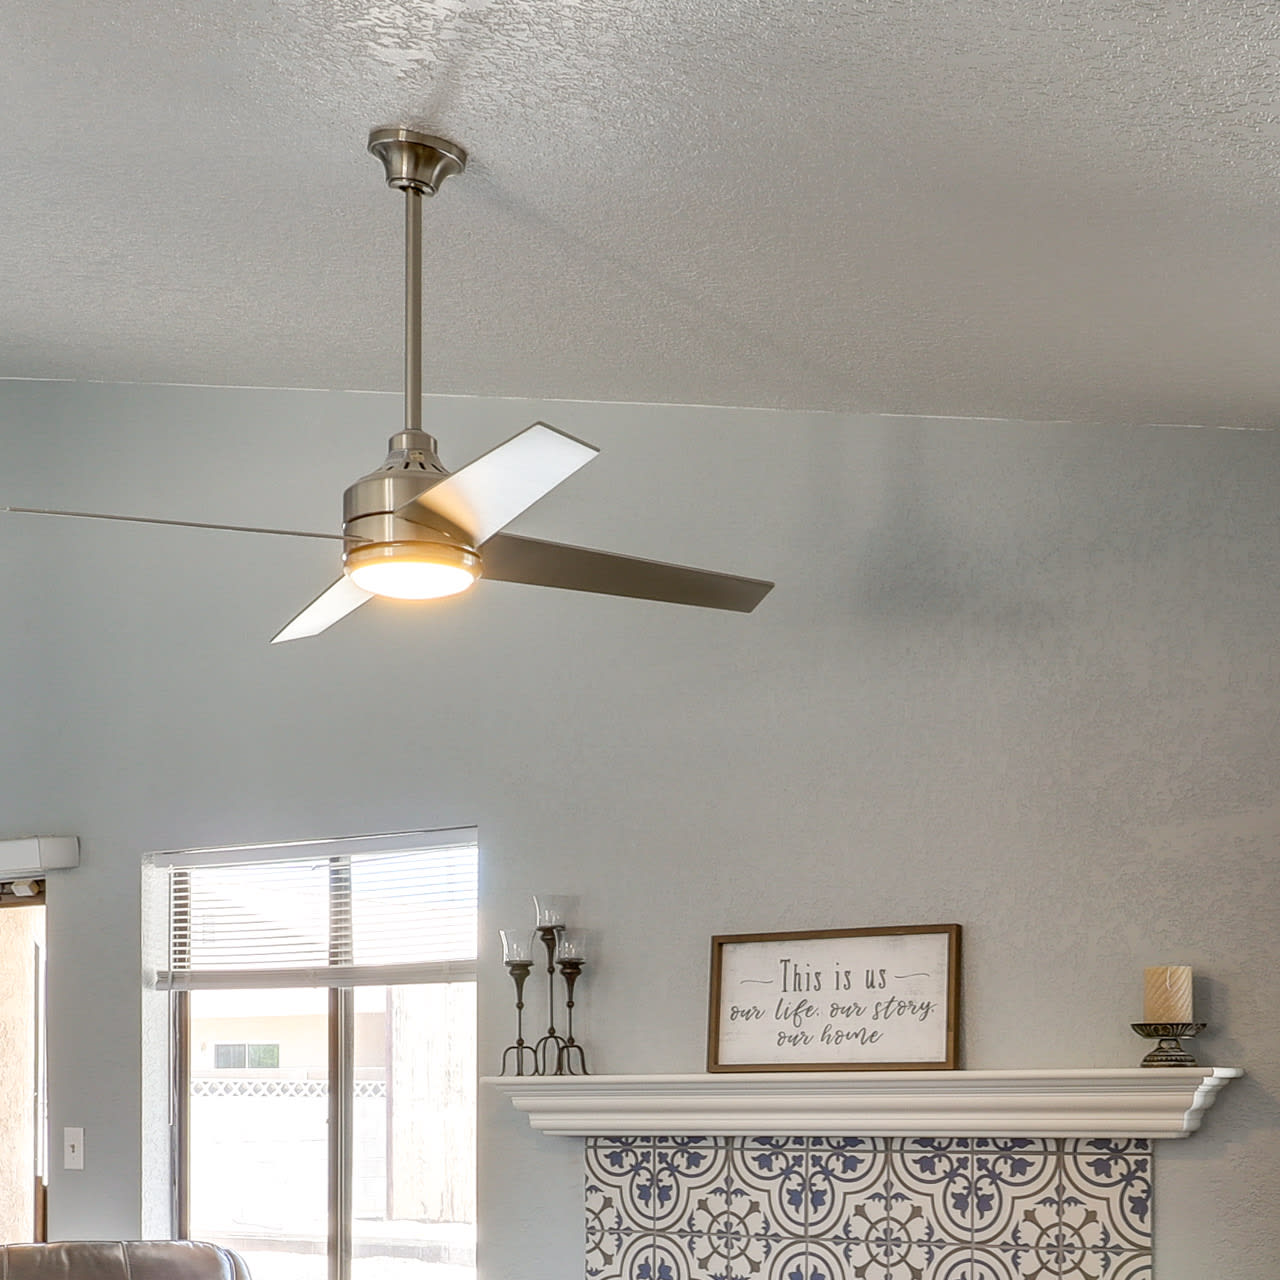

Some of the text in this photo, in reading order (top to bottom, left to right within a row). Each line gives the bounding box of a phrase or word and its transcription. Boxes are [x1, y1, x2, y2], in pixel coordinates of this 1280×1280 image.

[780, 958, 888, 993] This is us
[730, 1004, 766, 1021] our
[830, 1002, 868, 1018] our
[777, 1024, 883, 1046] our home
